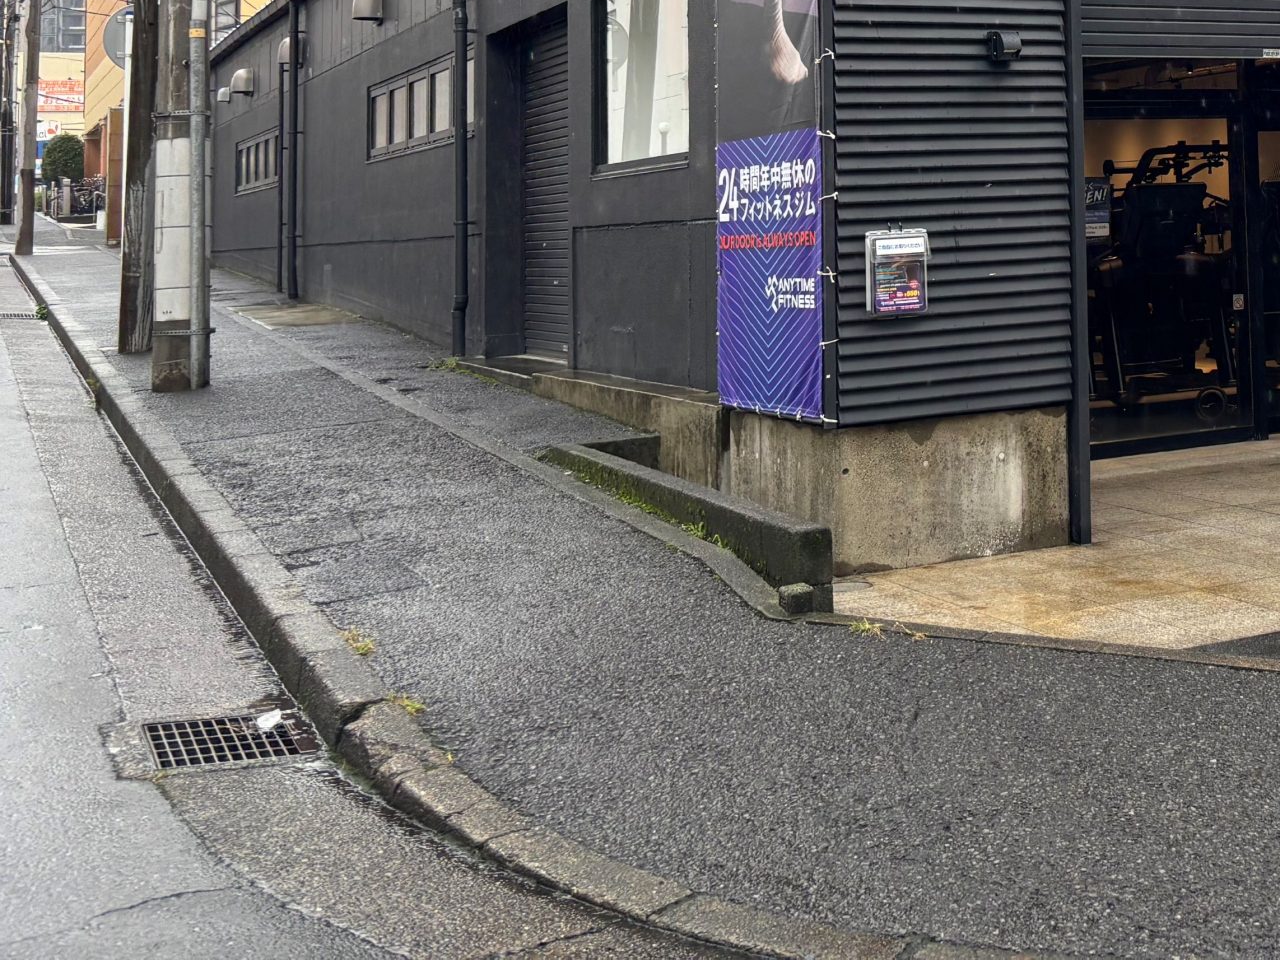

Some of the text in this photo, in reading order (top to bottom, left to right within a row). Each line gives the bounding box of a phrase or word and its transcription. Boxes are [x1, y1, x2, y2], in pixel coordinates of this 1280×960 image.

[740, 191, 816, 222] フィットネスジム
[735, 234, 755, 249] DOOR
[763, 232, 793, 247] ALWAYS
[794, 231, 816, 247] OPEN
[778, 277, 815, 292] ANYTIME
[778, 294, 815, 309] FITNESS
